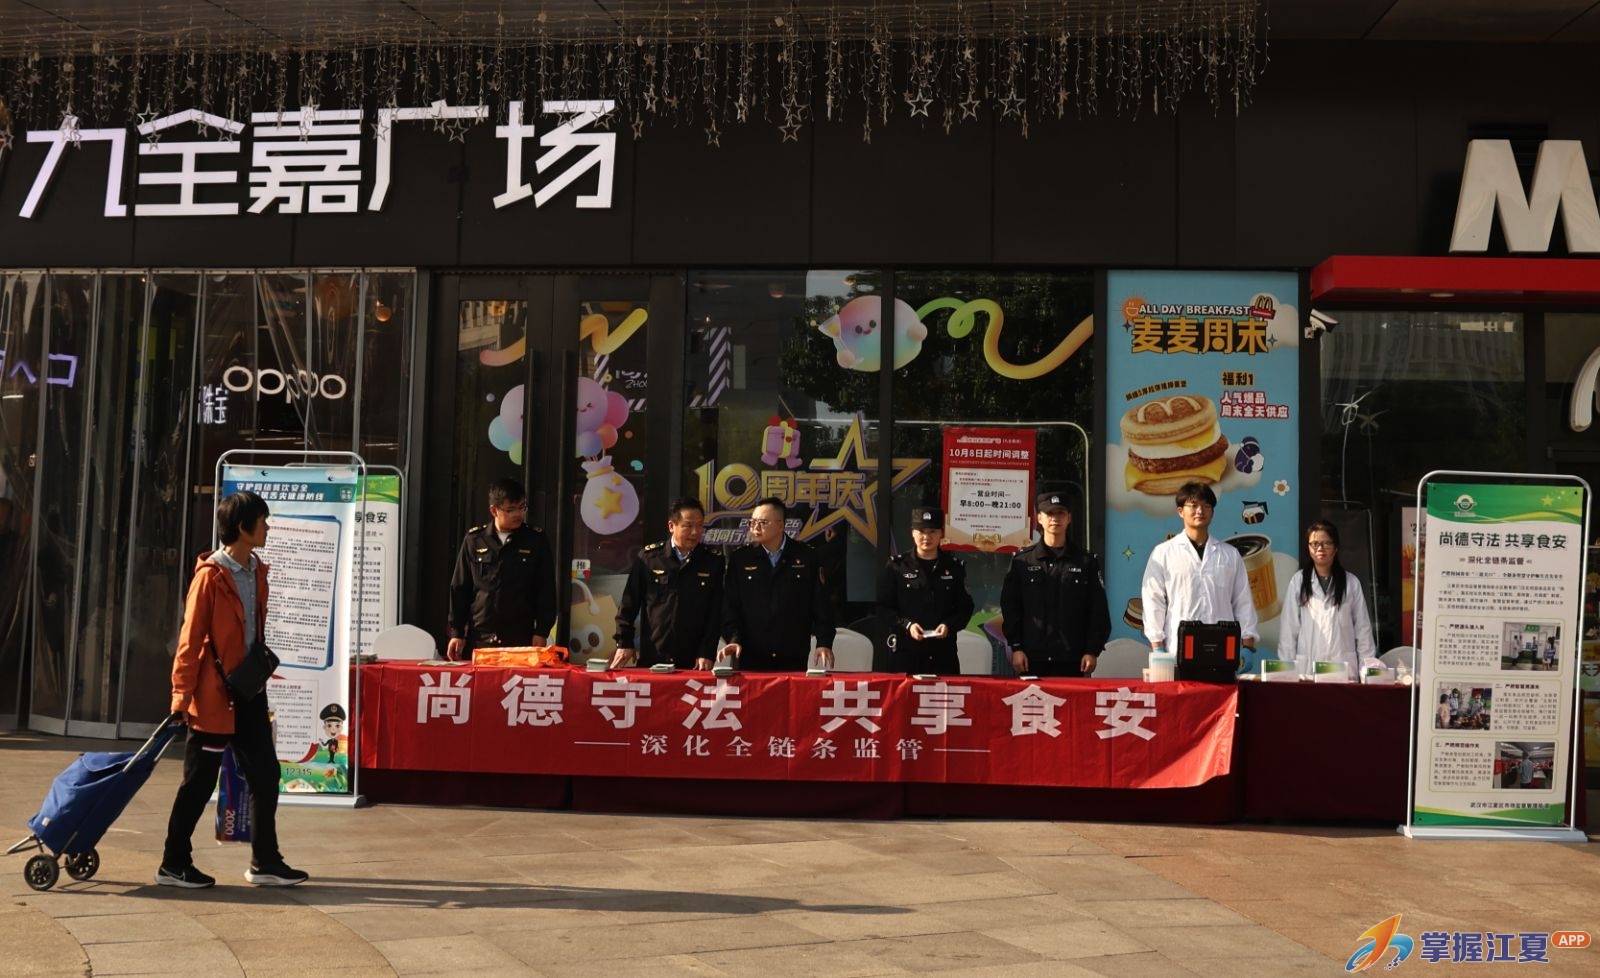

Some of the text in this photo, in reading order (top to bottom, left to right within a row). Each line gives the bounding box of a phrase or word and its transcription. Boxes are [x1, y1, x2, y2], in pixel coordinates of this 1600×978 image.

[19, 99, 616, 218] 九全嘉广场
[1139, 304, 1159, 314] ALL
[1162, 305, 1183, 315] DAY
[1186, 305, 1250, 316] BREAKFAST
[1131, 317, 1269, 354] 麦麦周末
[1222, 372, 1254, 386] 福利1
[1220, 405, 1289, 418] 周末全天供应
[949, 448, 1030, 460] 10月8日起时间调整
[695, 458, 867, 513] 10周年庆
[977, 490, 1005, 498] 营业时间
[1439, 531, 1567, 549] 尚德守法 共享食安
[416, 671, 1157, 741] 尚德守法 共享食安
[641, 734, 924, 761] 深化全链条监管
[285, 767, 312, 776] 12315
